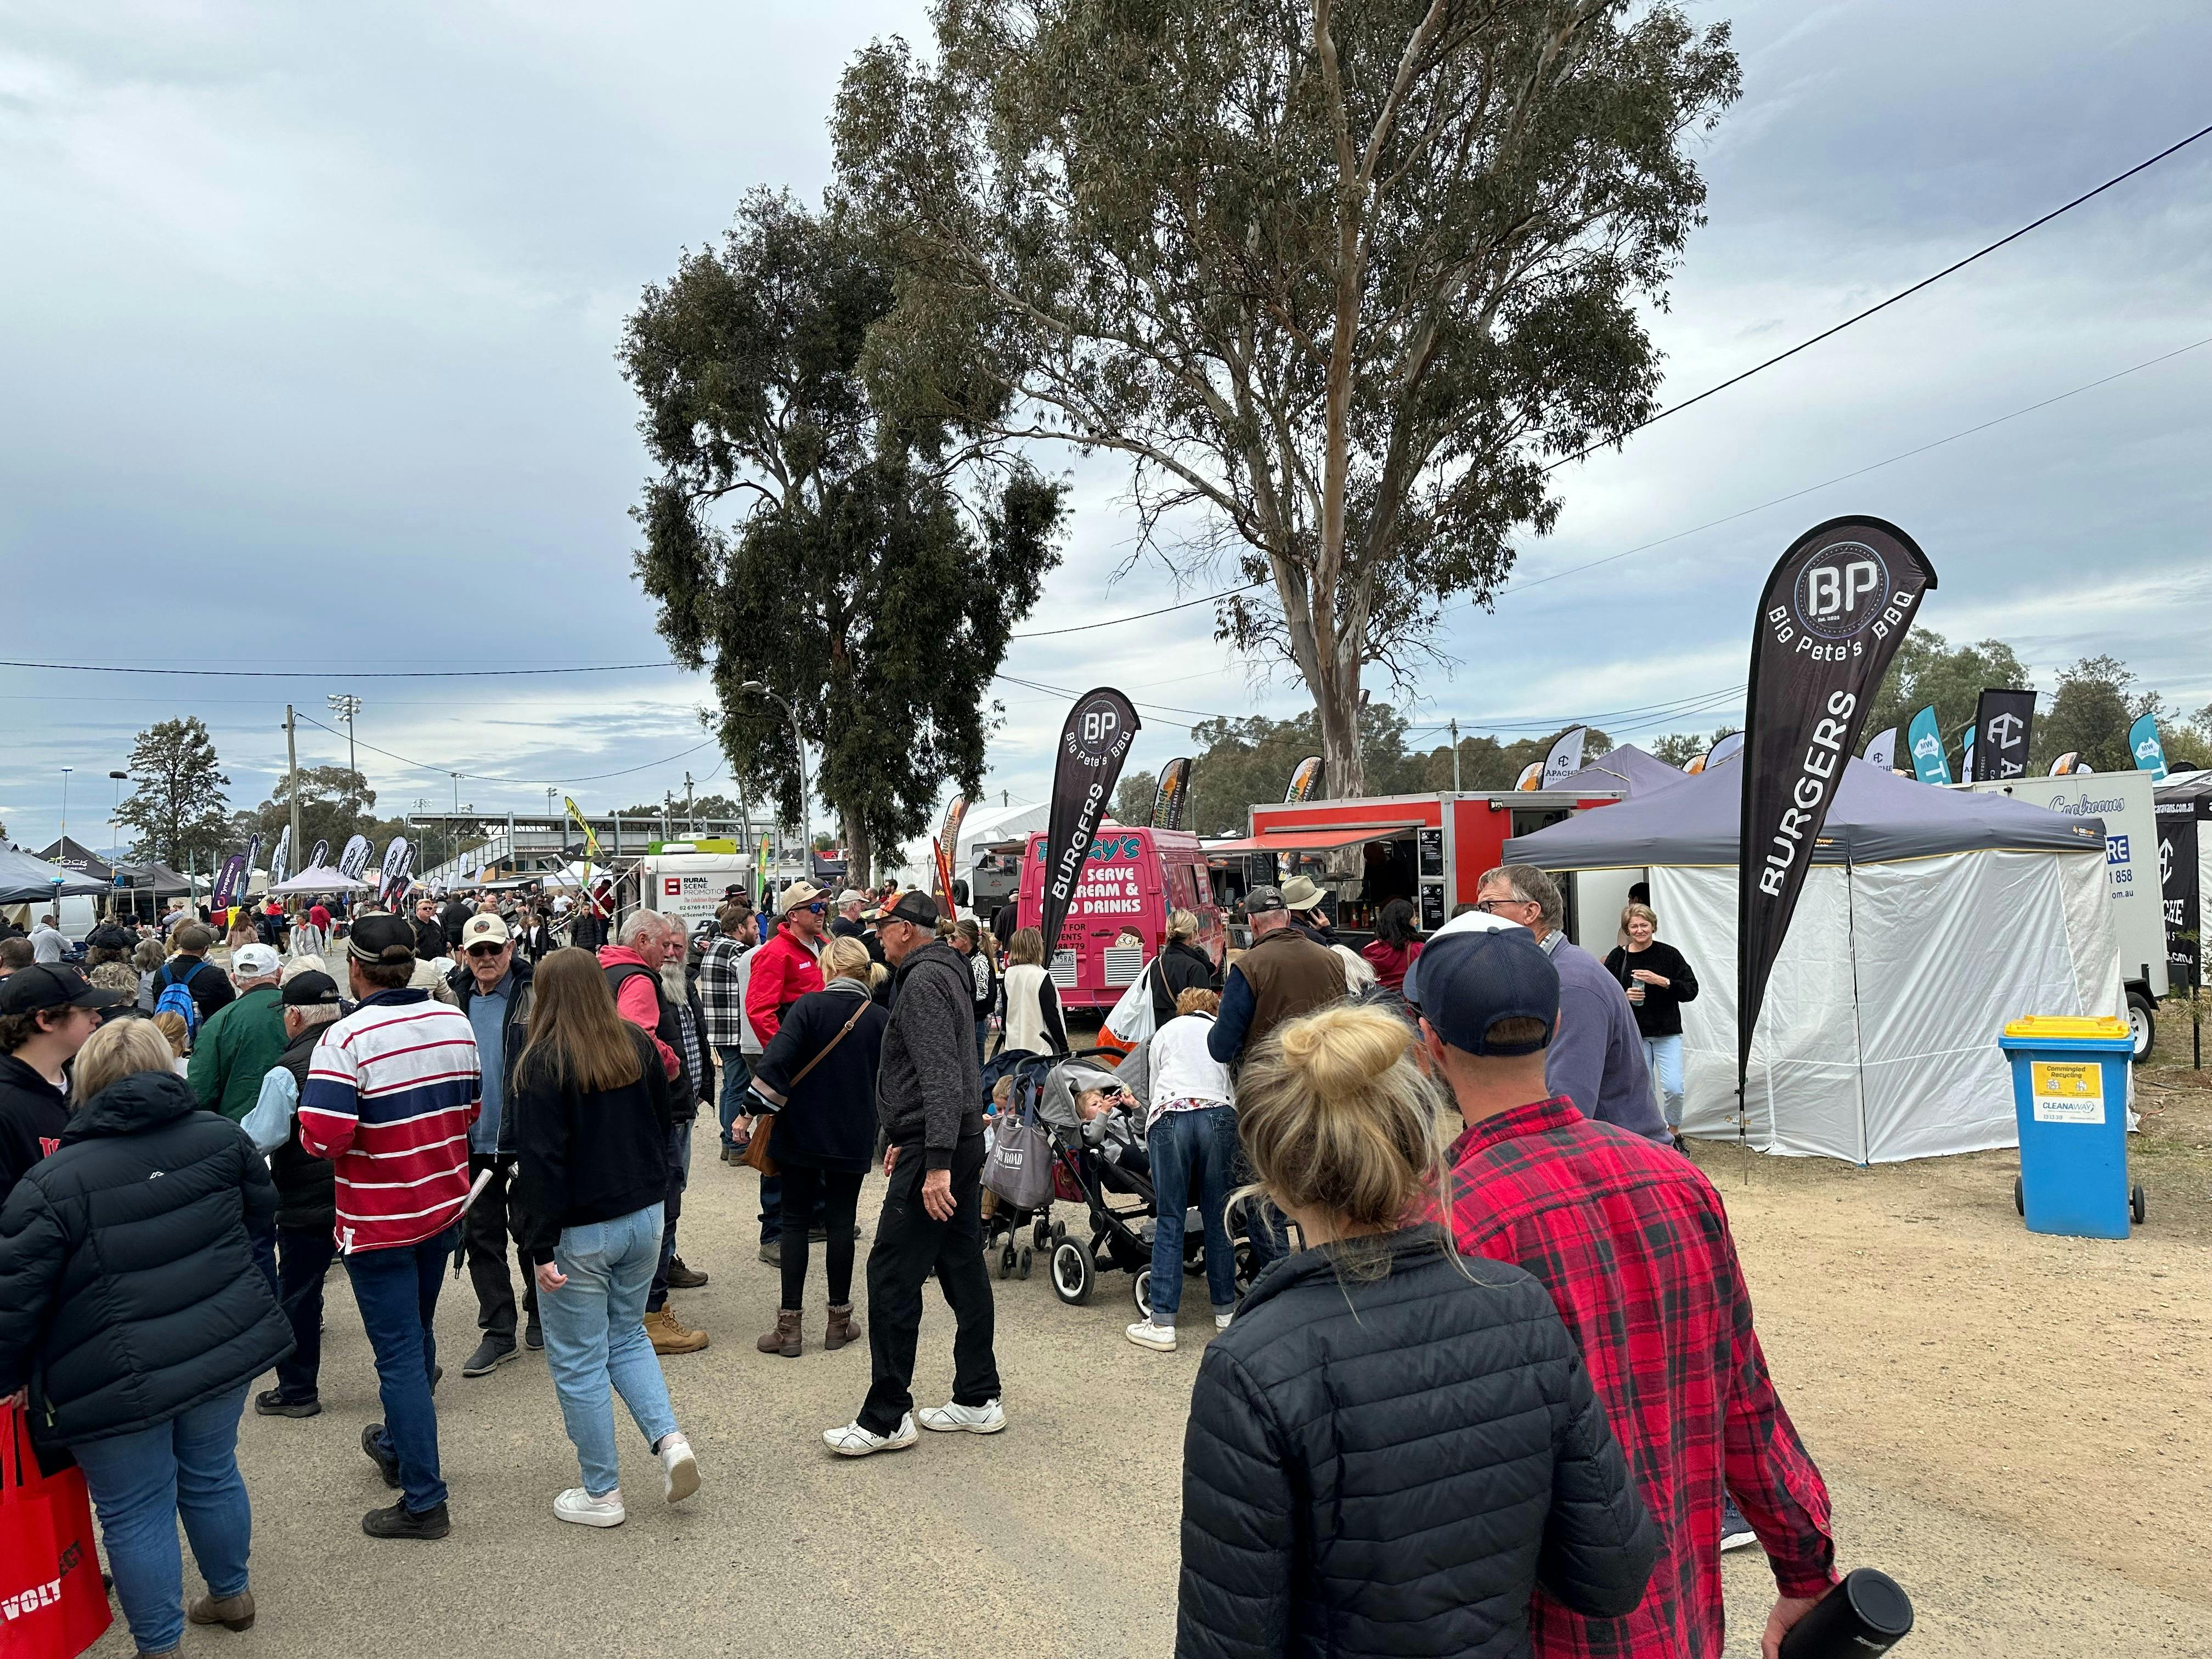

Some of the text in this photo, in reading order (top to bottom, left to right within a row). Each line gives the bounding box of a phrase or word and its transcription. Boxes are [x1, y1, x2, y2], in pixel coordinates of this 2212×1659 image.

[1809, 561, 1877, 616] BP
[1768, 591, 1915, 661] Big Pete's BBQ
[1084, 712, 1116, 740] BP
[1066, 731, 1131, 767] Big Pete's BBQ
[1920, 740, 1933, 750] MW
[2141, 743, 2153, 752] MW
[1759, 690, 1857, 897] BURGERS
[570, 805, 587, 830] ATM
[2154, 802, 2194, 814] caravans.com.au
[1036, 834, 1141, 862] PGY'S
[1051, 783, 1104, 900] BURGERS
[2107, 839, 2128, 861] RE
[220, 862, 235, 895] Tyrepower
[1087, 867, 1134, 882] SERVE
[2115, 869, 2132, 883] 858
[1073, 882, 1139, 898] REAM &
[2112, 889, 2134, 899] om.au
[1083, 899, 1141, 914] DRINKS
[1058, 933, 1082, 941] ENTS
[2042, 1102, 2092, 1110] CLEANAWAY
[1004, 1152, 1023, 1165] ROAD
[1, 1577, 61, 1621] VOLT
